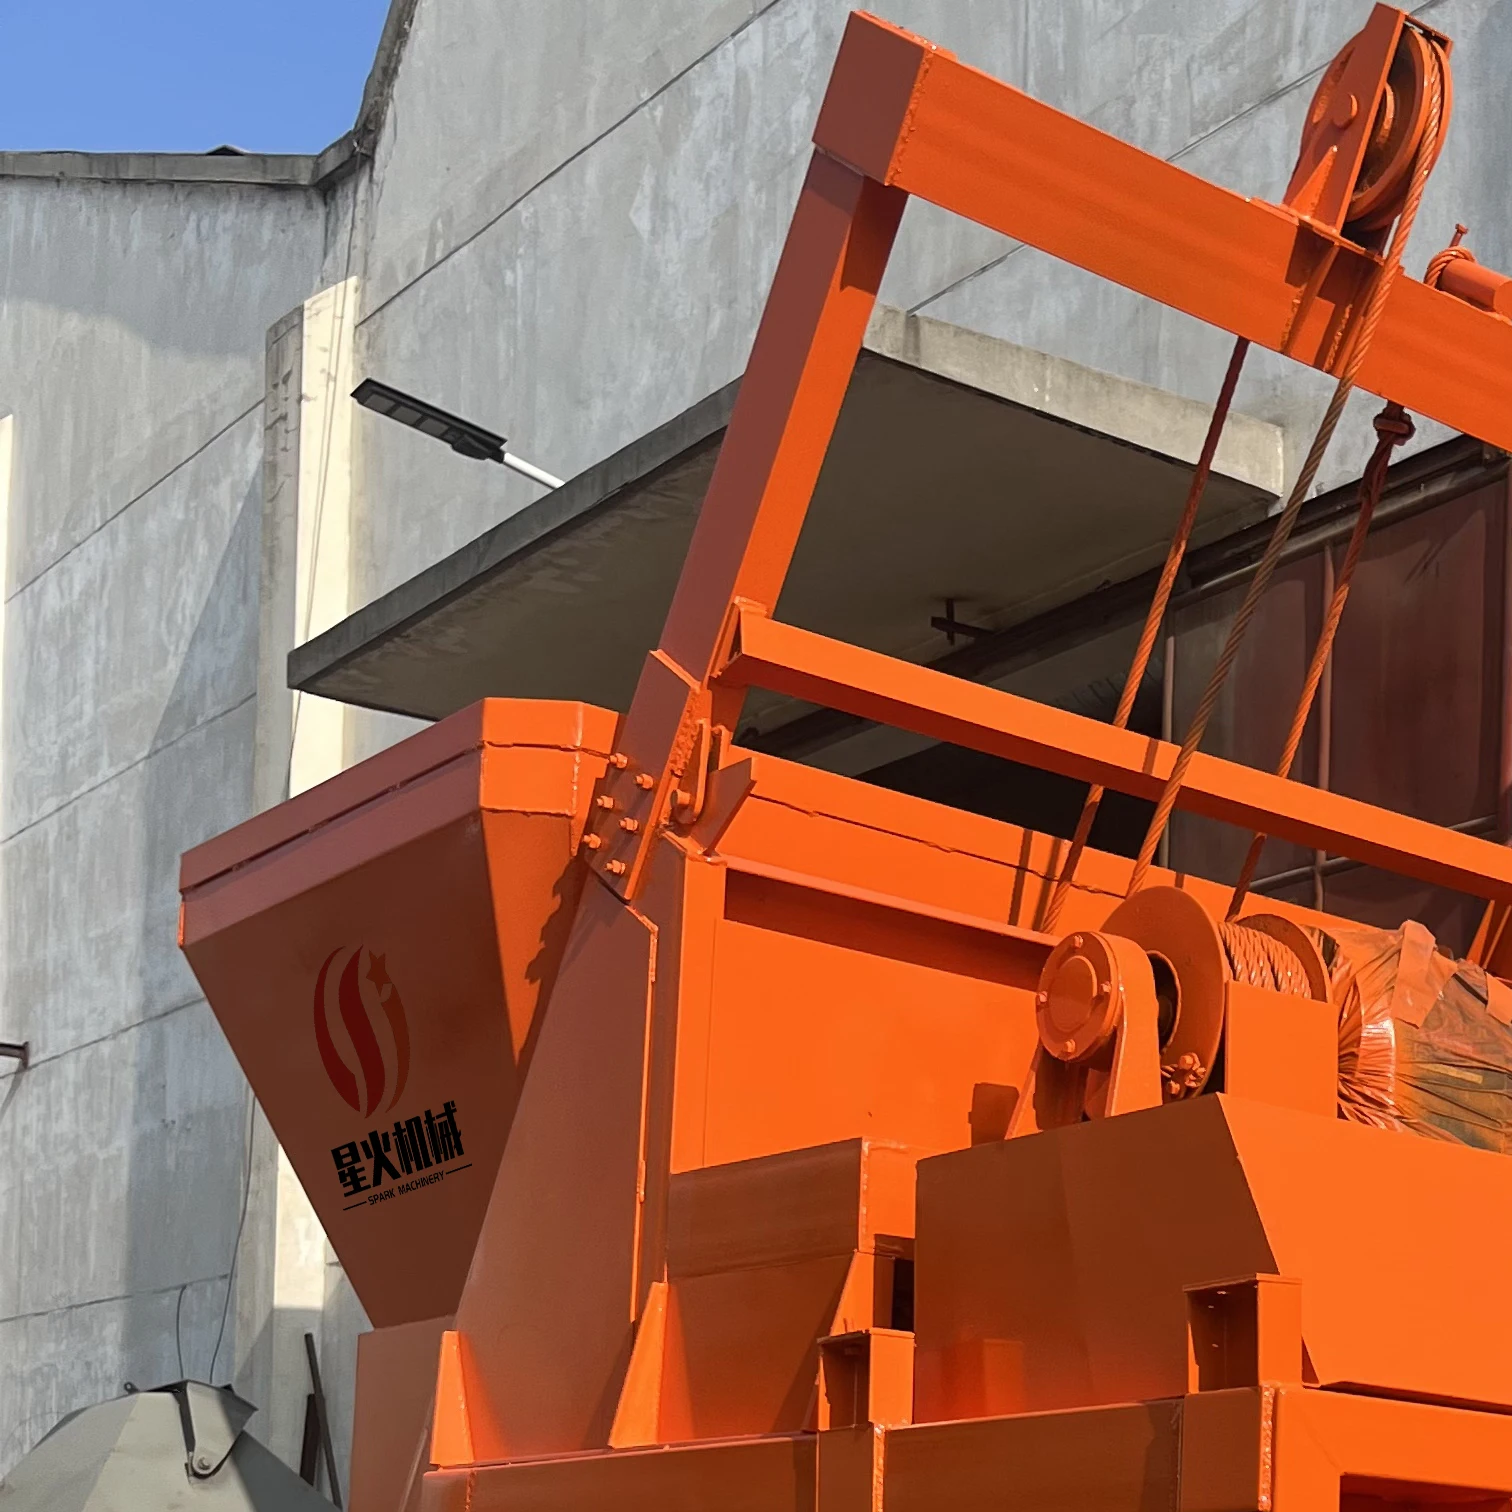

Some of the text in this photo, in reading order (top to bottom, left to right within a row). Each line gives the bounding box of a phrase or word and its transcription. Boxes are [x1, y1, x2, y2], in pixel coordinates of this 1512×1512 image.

[331, 1100, 464, 1197] 星火机械
[368, 1170, 444, 1206] SPARK MACHINERY
